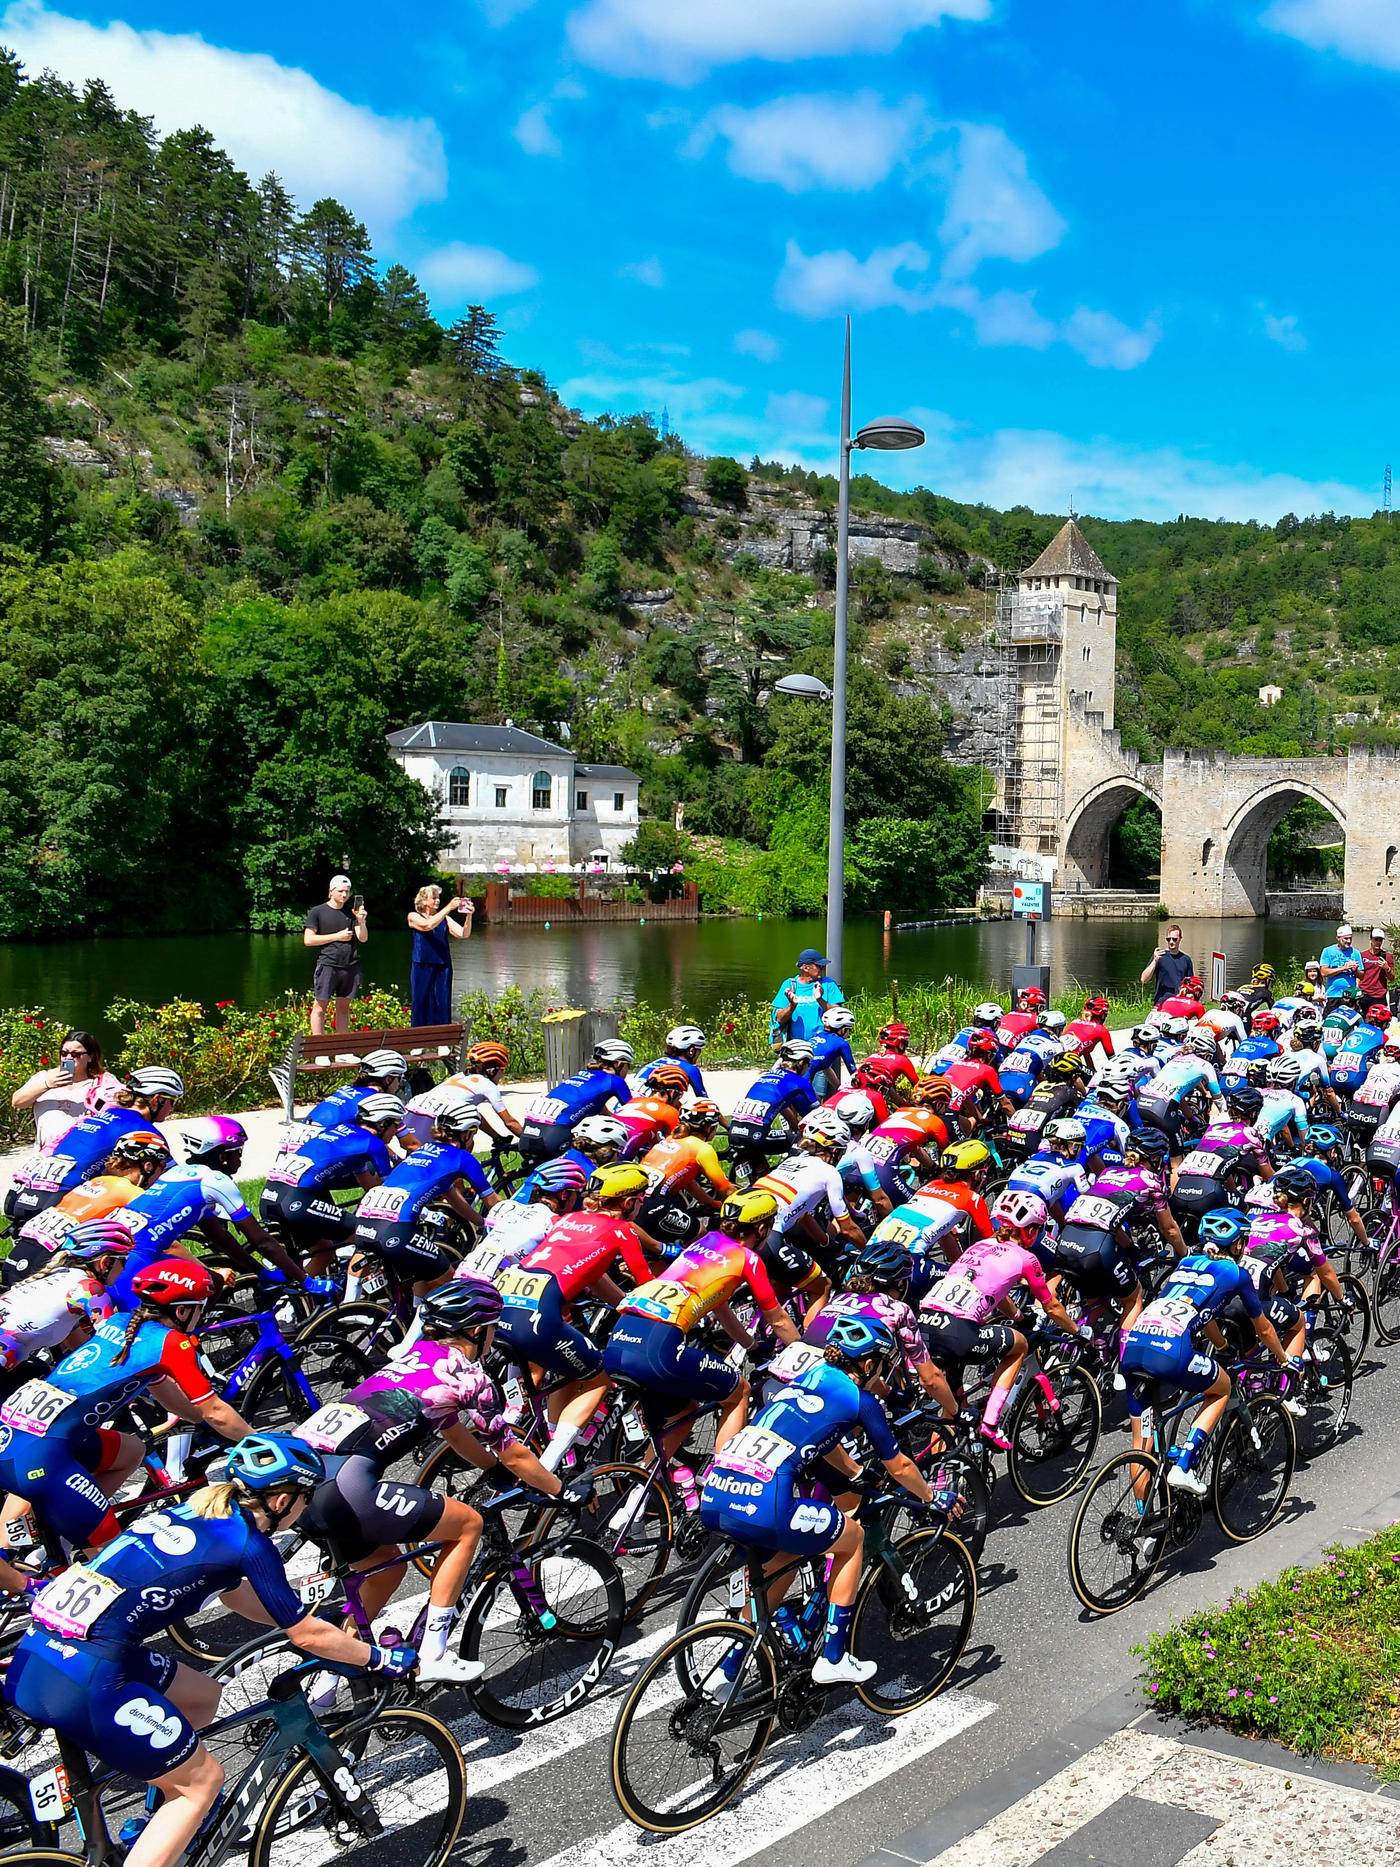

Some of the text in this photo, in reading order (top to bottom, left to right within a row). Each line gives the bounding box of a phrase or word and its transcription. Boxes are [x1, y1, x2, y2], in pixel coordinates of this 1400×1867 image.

[1011, 1056, 1030, 1069] 103
[1372, 1090, 1390, 1101] 165
[1024, 1112, 1040, 1124] 34
[1349, 1111, 1377, 1124] Cofidis
[867, 1139, 893, 1158] 153
[1197, 1155, 1215, 1169] 94
[1220, 1155, 1240, 1176] CADEX
[310, 1199, 343, 1217] FENIX
[374, 1192, 403, 1211] 116
[412, 1184, 441, 1213] Elegant
[1227, 1191, 1240, 1206] Liv
[783, 1201, 808, 1224] CADEX
[1090, 1202, 1113, 1222] 92
[1112, 1202, 1134, 1228] CADEX
[148, 1205, 193, 1241] Jayco
[410, 1233, 440, 1254] FENIX
[891, 1226, 911, 1243] 15
[571, 1246, 607, 1268] sdworx
[778, 1245, 799, 1269] Liv
[1059, 1239, 1085, 1254] TeqFind
[474, 1251, 496, 1271] 47
[1266, 1252, 1289, 1279] CADEX
[158, 1270, 196, 1290] KASK
[369, 1275, 385, 1291] 116
[1113, 1261, 1129, 1285] Liv
[511, 1277, 538, 1297] 16
[649, 1285, 678, 1305] 12
[945, 1285, 970, 1307] 81
[1160, 1301, 1189, 1322] 52
[1270, 1301, 1289, 1324] Liv
[619, 1331, 643, 1344] sdworx
[563, 1346, 588, 1372] sdworx
[708, 1359, 732, 1374] sdworx
[792, 1350, 823, 1372] 97
[235, 1361, 257, 1386] Liv
[506, 1386, 519, 1400] 16
[316, 1408, 352, 1436] 95
[625, 1417, 639, 1433] 12
[1142, 1415, 1149, 1429] 52
[375, 1418, 418, 1451] CADEX
[746, 1436, 781, 1464] 51
[290, 1464, 317, 1478] SCOTT
[65, 1473, 110, 1512] CERATIZIT
[375, 1482, 417, 1517] Liv
[6, 1518, 26, 1543] 196
[55, 1576, 101, 1619] 56
[308, 1584, 325, 1602] 95
[732, 1579, 743, 1599] 51
[126, 1577, 206, 1624] eyes more
[525, 1638, 614, 1723] CADEX
[128, 1706, 174, 1738] dsm-firmenich
[35, 1782, 57, 1809] 56
